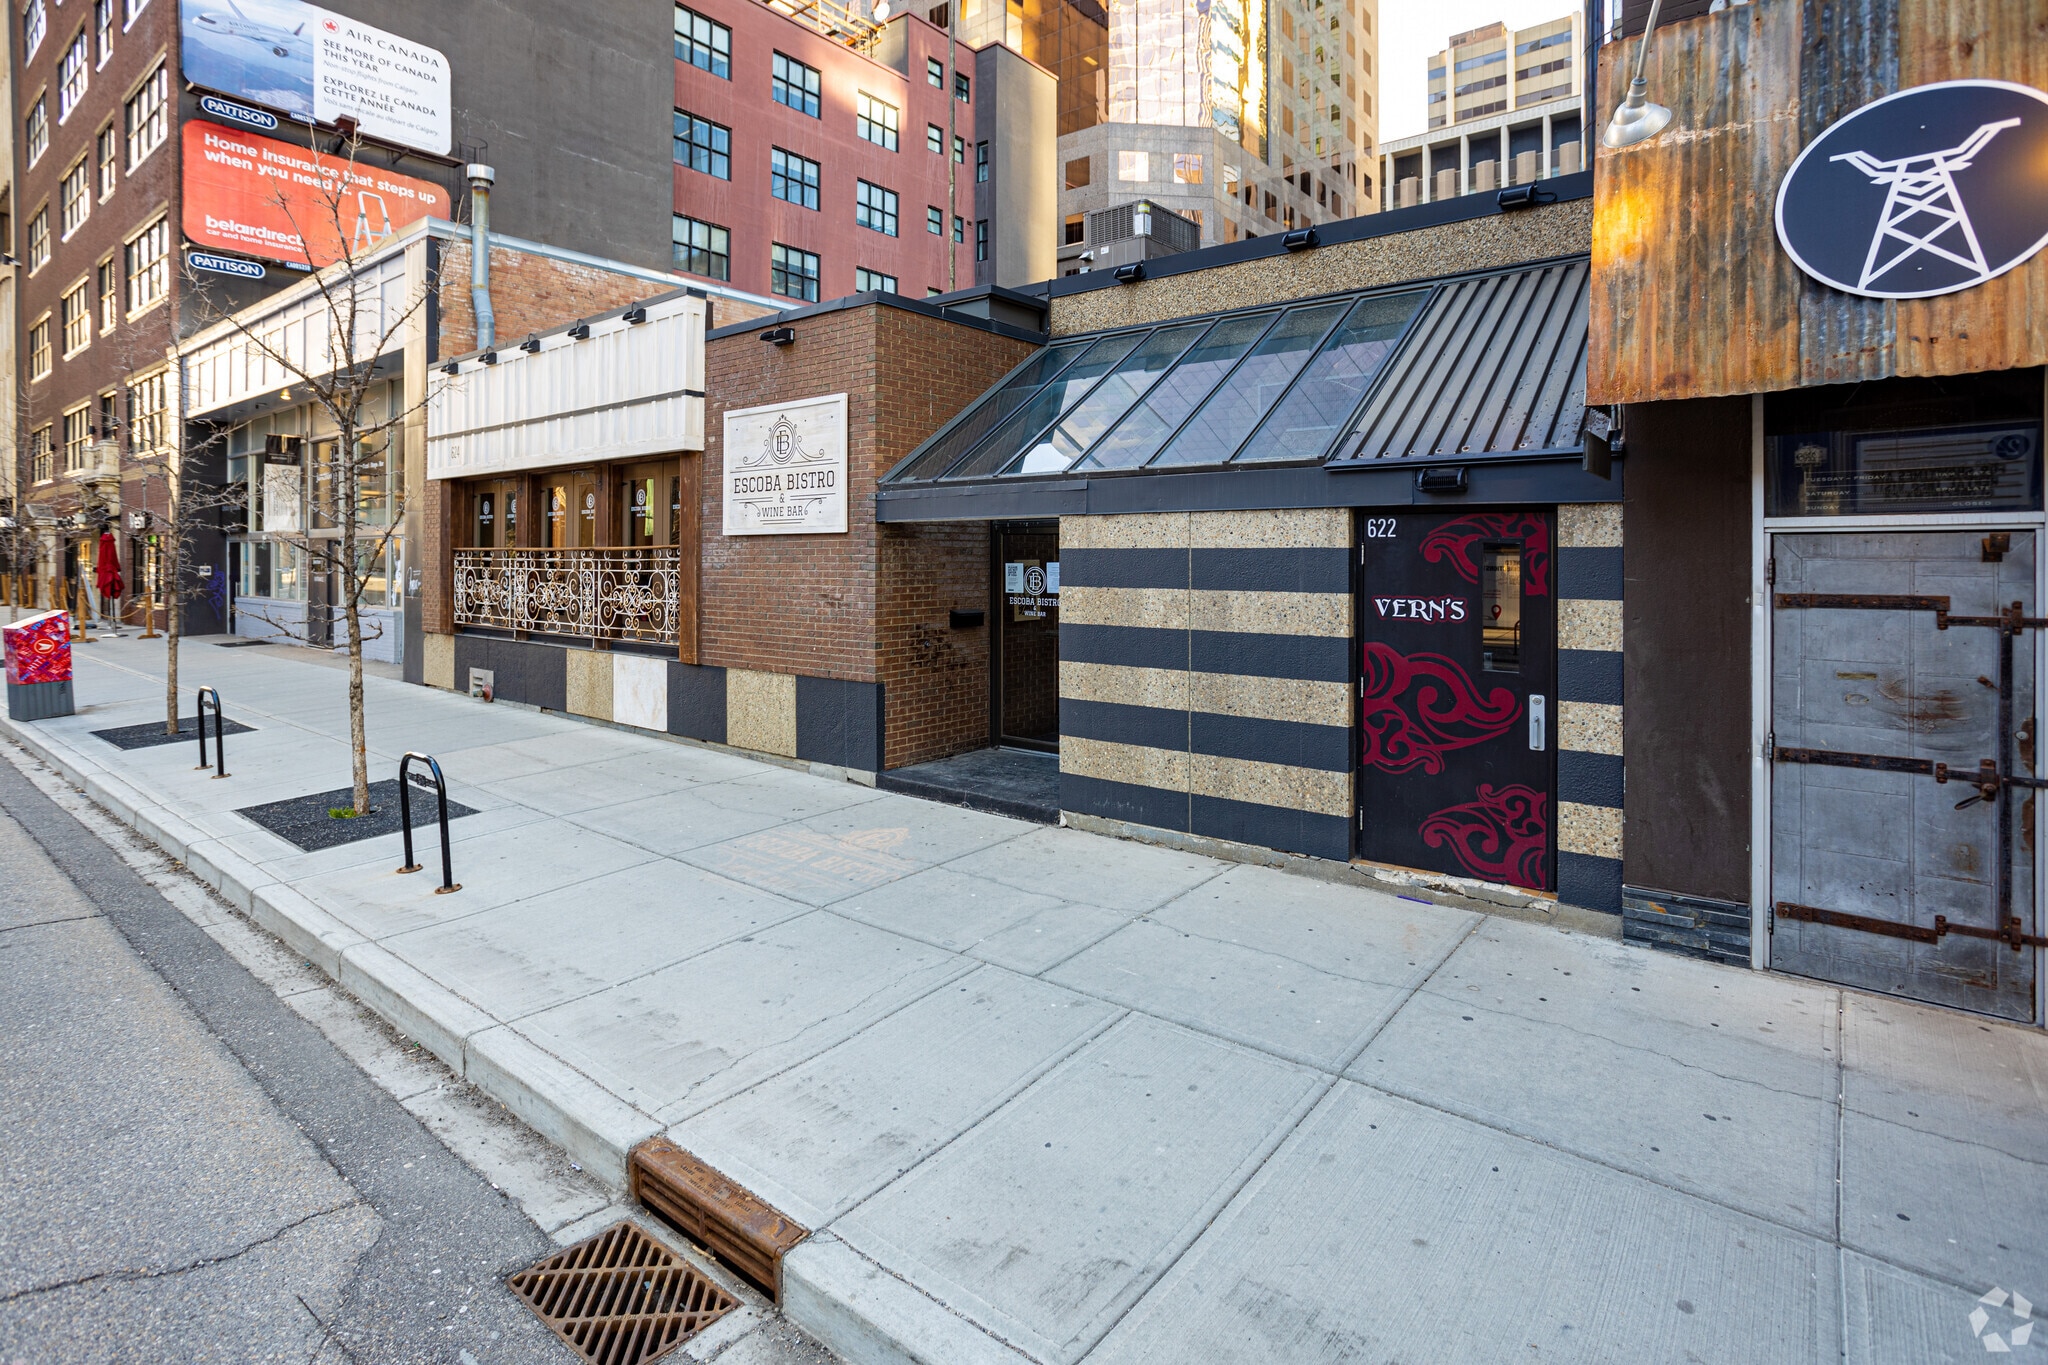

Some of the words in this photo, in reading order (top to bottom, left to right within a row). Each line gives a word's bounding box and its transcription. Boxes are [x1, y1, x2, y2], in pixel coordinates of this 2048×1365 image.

[346, 28, 373, 45] AIR
[377, 39, 439, 68] CANADA
[323, 38, 341, 50] SEE
[345, 46, 375, 62] MORE
[378, 57, 391, 67] OF
[395, 63, 437, 83] CANADA
[323, 48, 348, 62] THIS
[352, 58, 379, 73] YEAR
[356, 69, 377, 83] flights
[378, 75, 394, 87] from
[323, 75, 376, 99] EXPLOREZ
[380, 92, 390, 103] LE
[394, 97, 436, 117] CANADA
[323, 85, 356, 102] CETTE
[360, 95, 395, 114] ANNÉE
[207, 99, 272, 127] PATTISON
[340, 101, 354, 111] sans
[376, 112, 384, 120] au
[407, 120, 415, 129] de
[204, 132, 258, 157] Home
[262, 147, 339, 178] insurance
[343, 169, 374, 188] that
[377, 181, 415, 198] steps
[418, 191, 436, 204] up
[204, 149, 253, 171] when
[257, 163, 289, 180] you
[293, 172, 333, 191] need
[206, 228, 221, 237] car
[222, 231, 239, 240] and
[240, 234, 263, 245] home
[194, 255, 261, 276] PATTISON
[733, 475, 782, 494] ESCOBA
[787, 470, 835, 490] BISTRO
[779, 492, 785, 504] &
[761, 506, 785, 518] WINE
[787, 505, 804, 517] BAR
[1367, 518, 1397, 538] 622
[1009, 596, 1035, 606] ESCOBA
[1375, 598, 1465, 621] VERN'S
